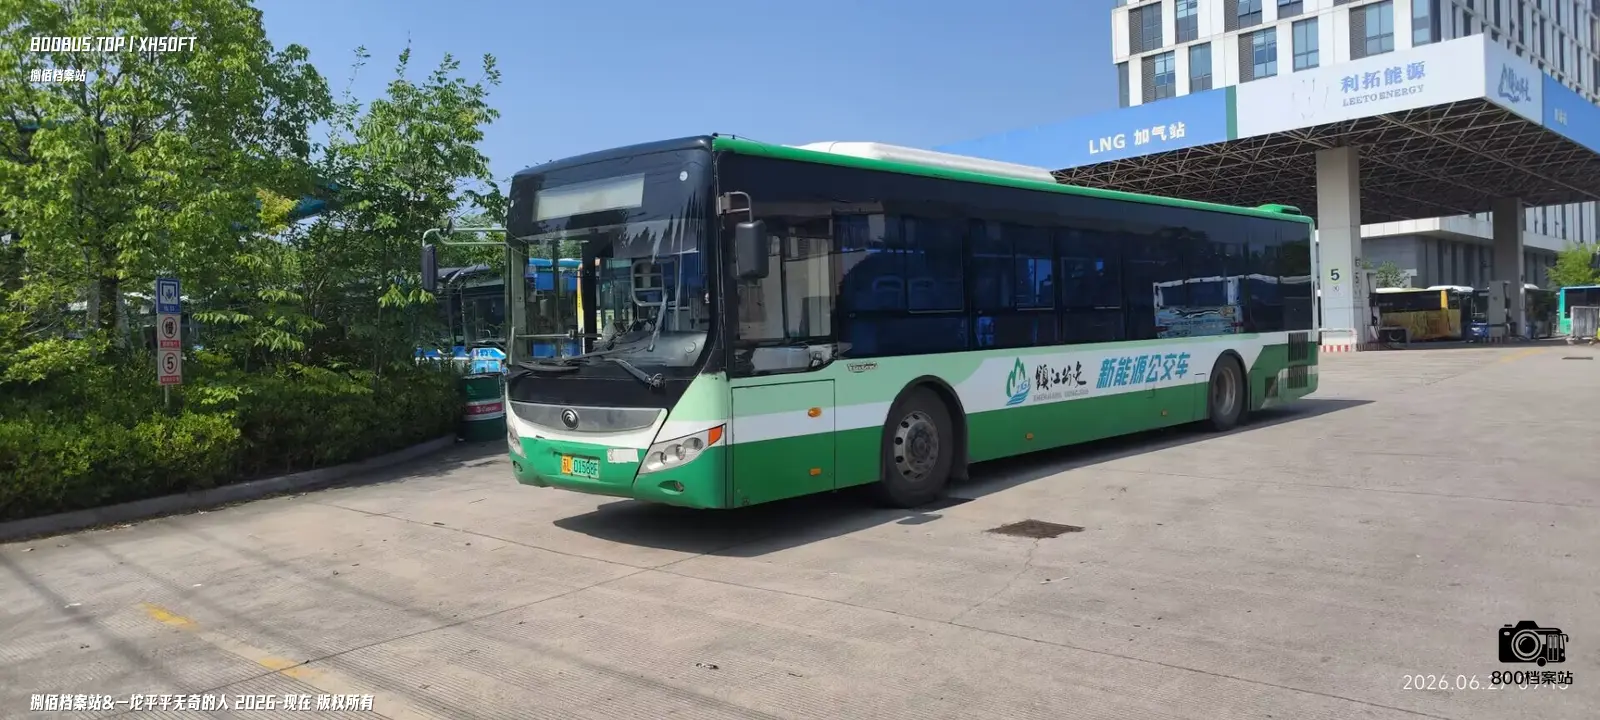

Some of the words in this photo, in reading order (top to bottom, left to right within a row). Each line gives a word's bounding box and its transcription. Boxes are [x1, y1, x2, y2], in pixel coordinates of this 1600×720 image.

[1341, 61, 1426, 93] 利拓能源
[1342, 91, 1378, 107] LEETO
[1379, 84, 1425, 101] ENERGY
[1088, 133, 1126, 155] LNG
[1133, 121, 1186, 146] 加气站
[1331, 268, 1340, 281] 5
[167, 356, 173, 370] 5
[1095, 351, 1191, 389] 新能源公交车
